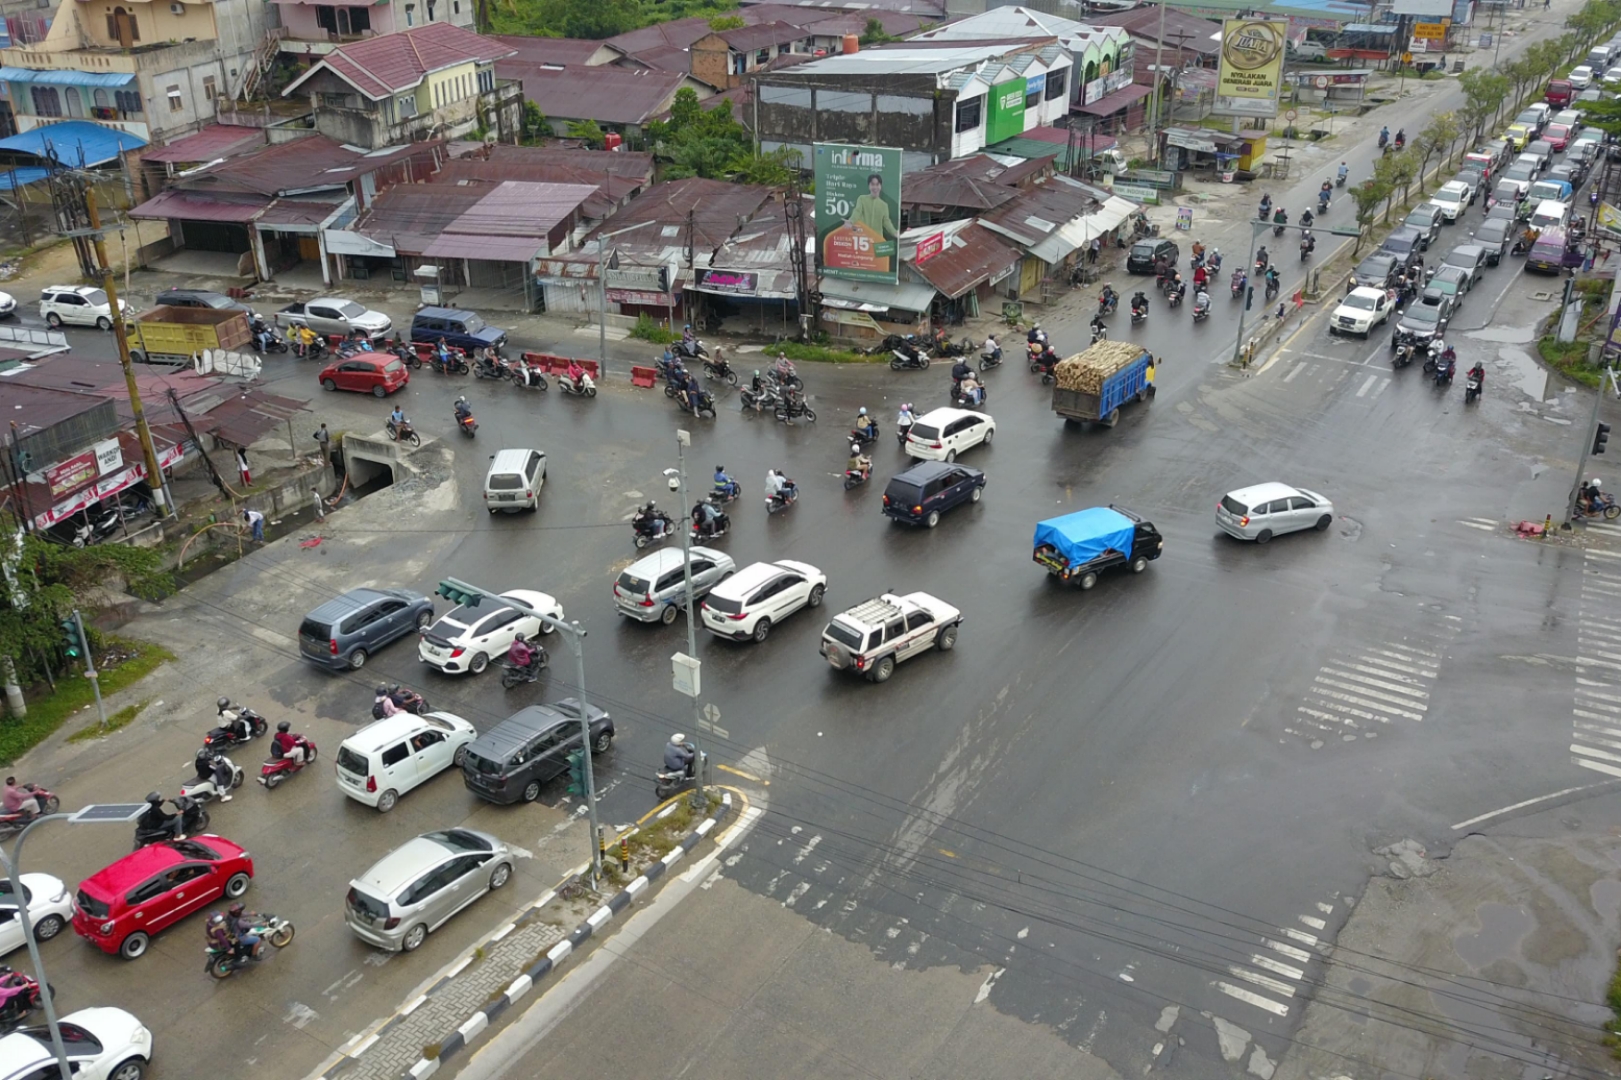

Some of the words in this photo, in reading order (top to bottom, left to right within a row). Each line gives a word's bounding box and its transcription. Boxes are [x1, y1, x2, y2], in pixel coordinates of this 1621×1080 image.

[1235, 37, 1267, 51] JUARA
[1230, 72, 1266, 80] NYALAKAN
[1223, 78, 1251, 86] GENERASI
[831, 149, 883, 168] informa
[825, 173, 845, 181] Triple
[1126, 188, 1154, 197] INDONESIA
